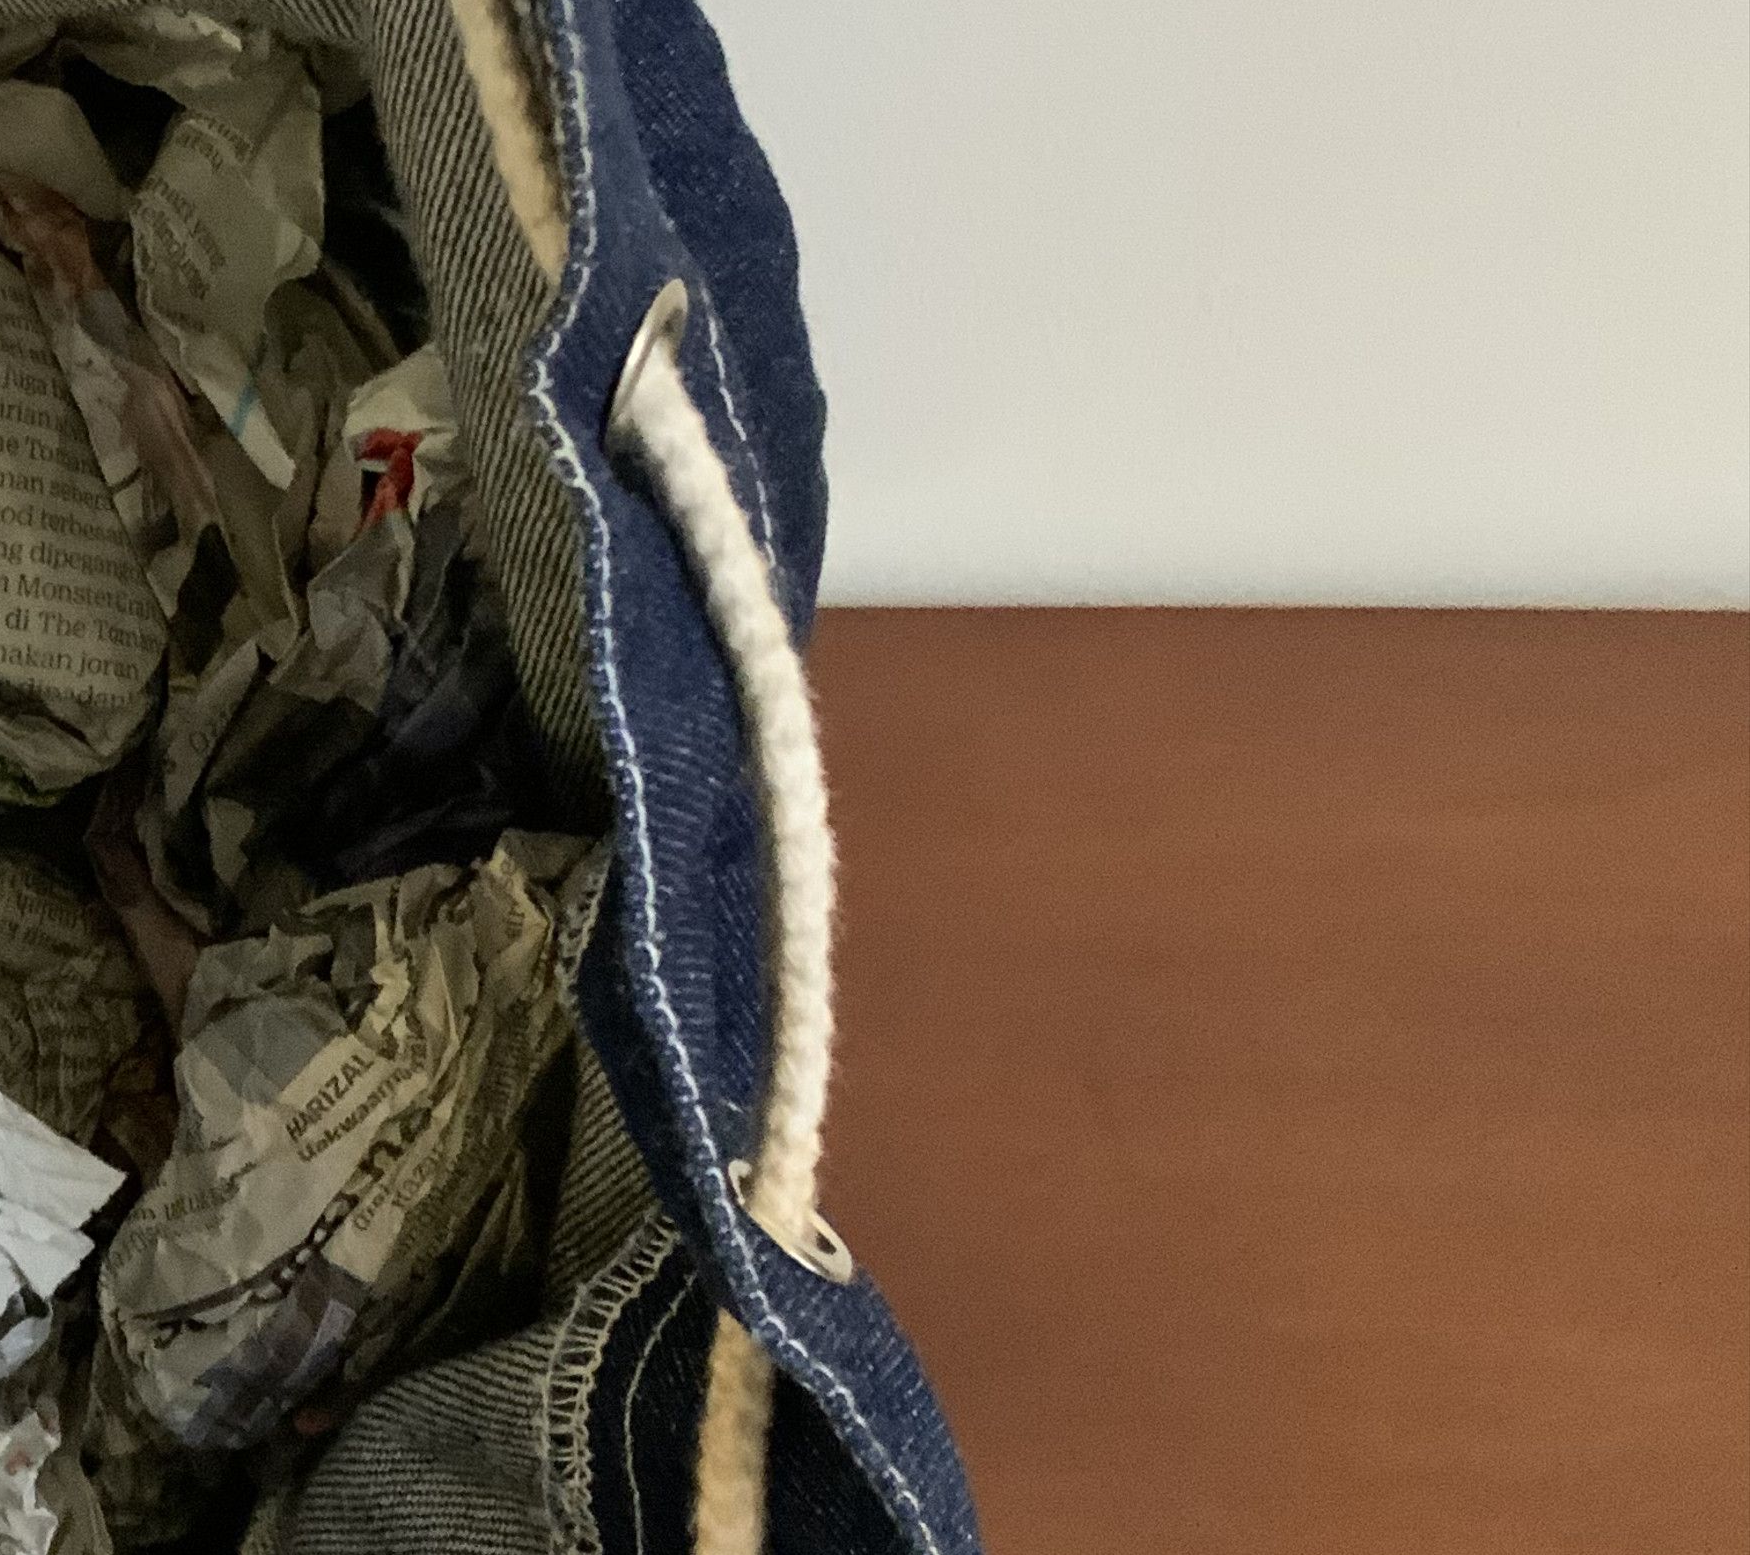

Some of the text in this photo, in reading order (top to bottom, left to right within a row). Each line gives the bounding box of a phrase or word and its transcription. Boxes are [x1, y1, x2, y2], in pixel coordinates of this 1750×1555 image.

[4, 606, 31, 631] di
[38, 610, 87, 640] The
[76, 650, 140, 681] joran
[284, 1053, 376, 1143] HARIZAL
